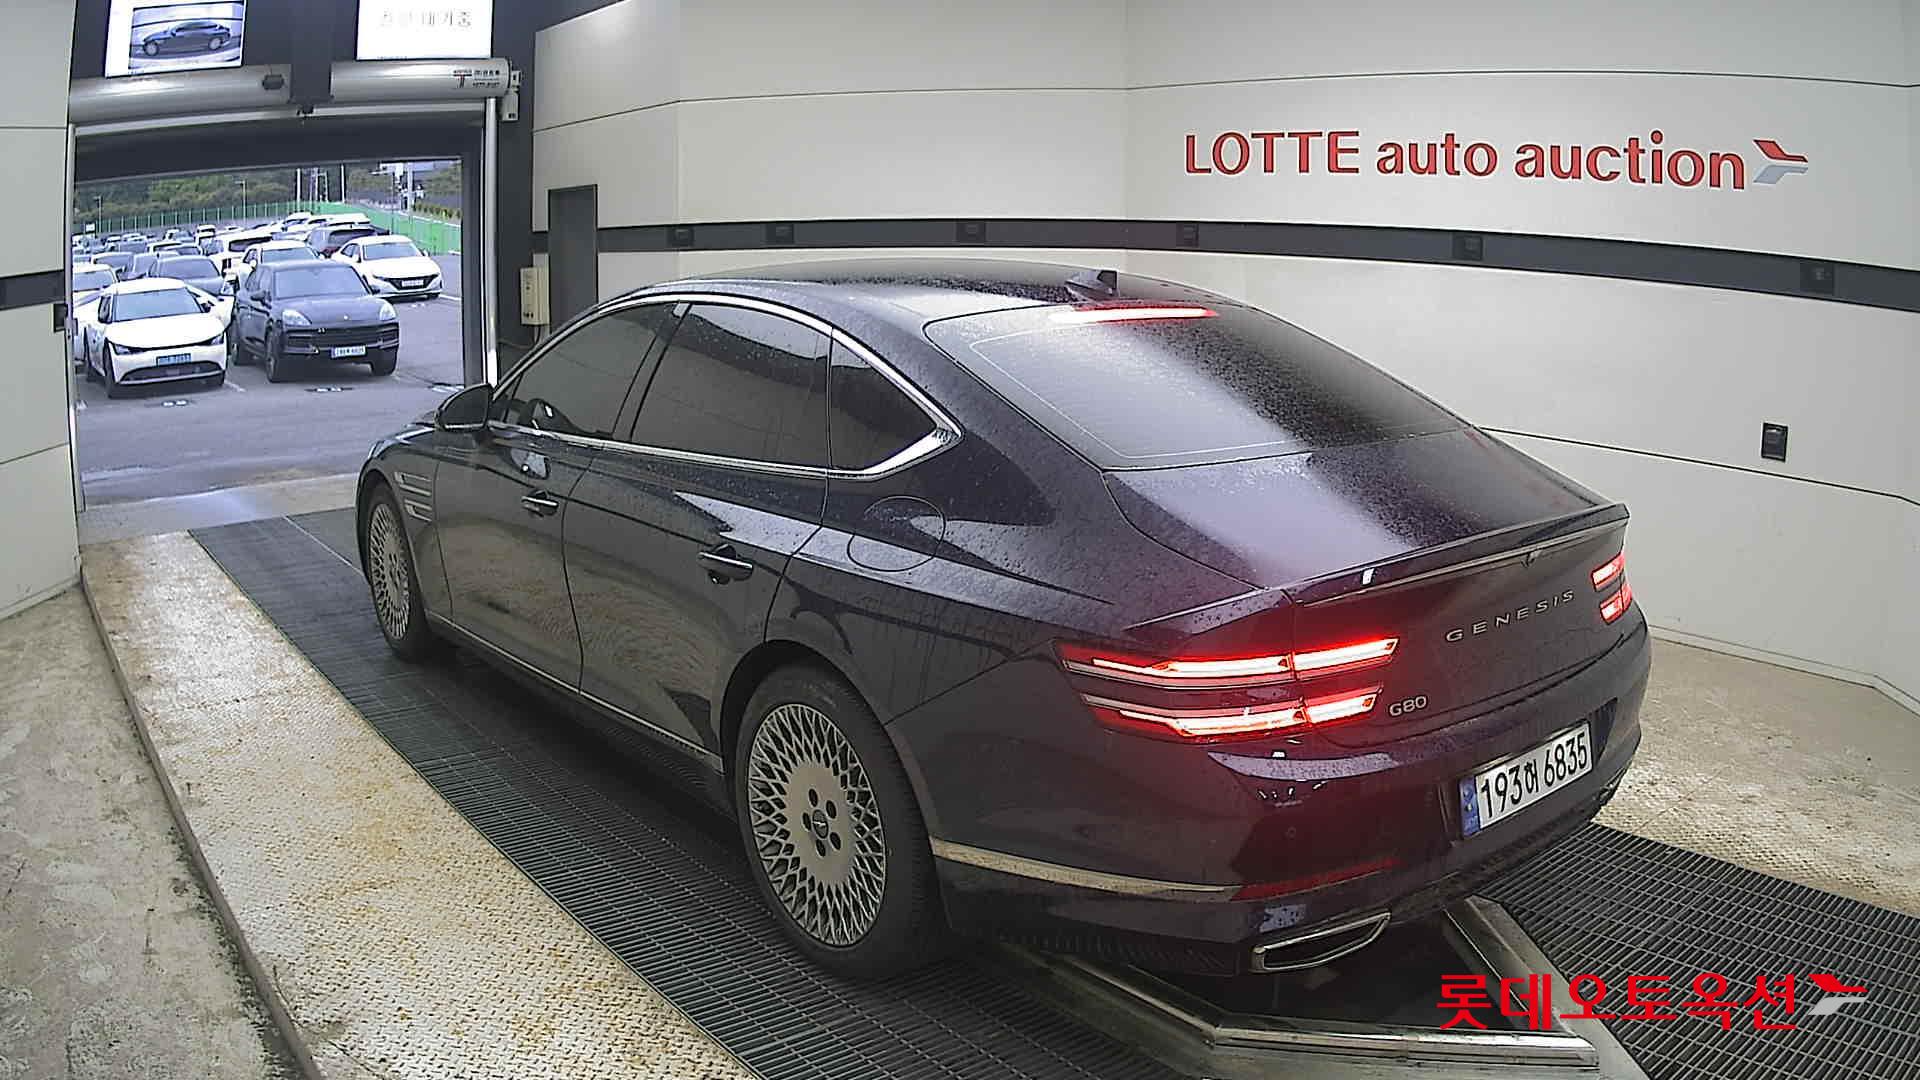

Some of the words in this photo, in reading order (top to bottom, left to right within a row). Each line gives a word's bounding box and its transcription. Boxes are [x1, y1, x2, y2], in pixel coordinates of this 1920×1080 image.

[1185, 131, 1360, 174] LOTTE
[1377, 133, 1498, 176] auto
[1514, 130, 1745, 189] auction
[1446, 590, 1574, 642] GENESIS
[1389, 696, 1427, 717] G80
[1481, 758, 1539, 818] 193허
[1544, 732, 1588, 787] 6835
